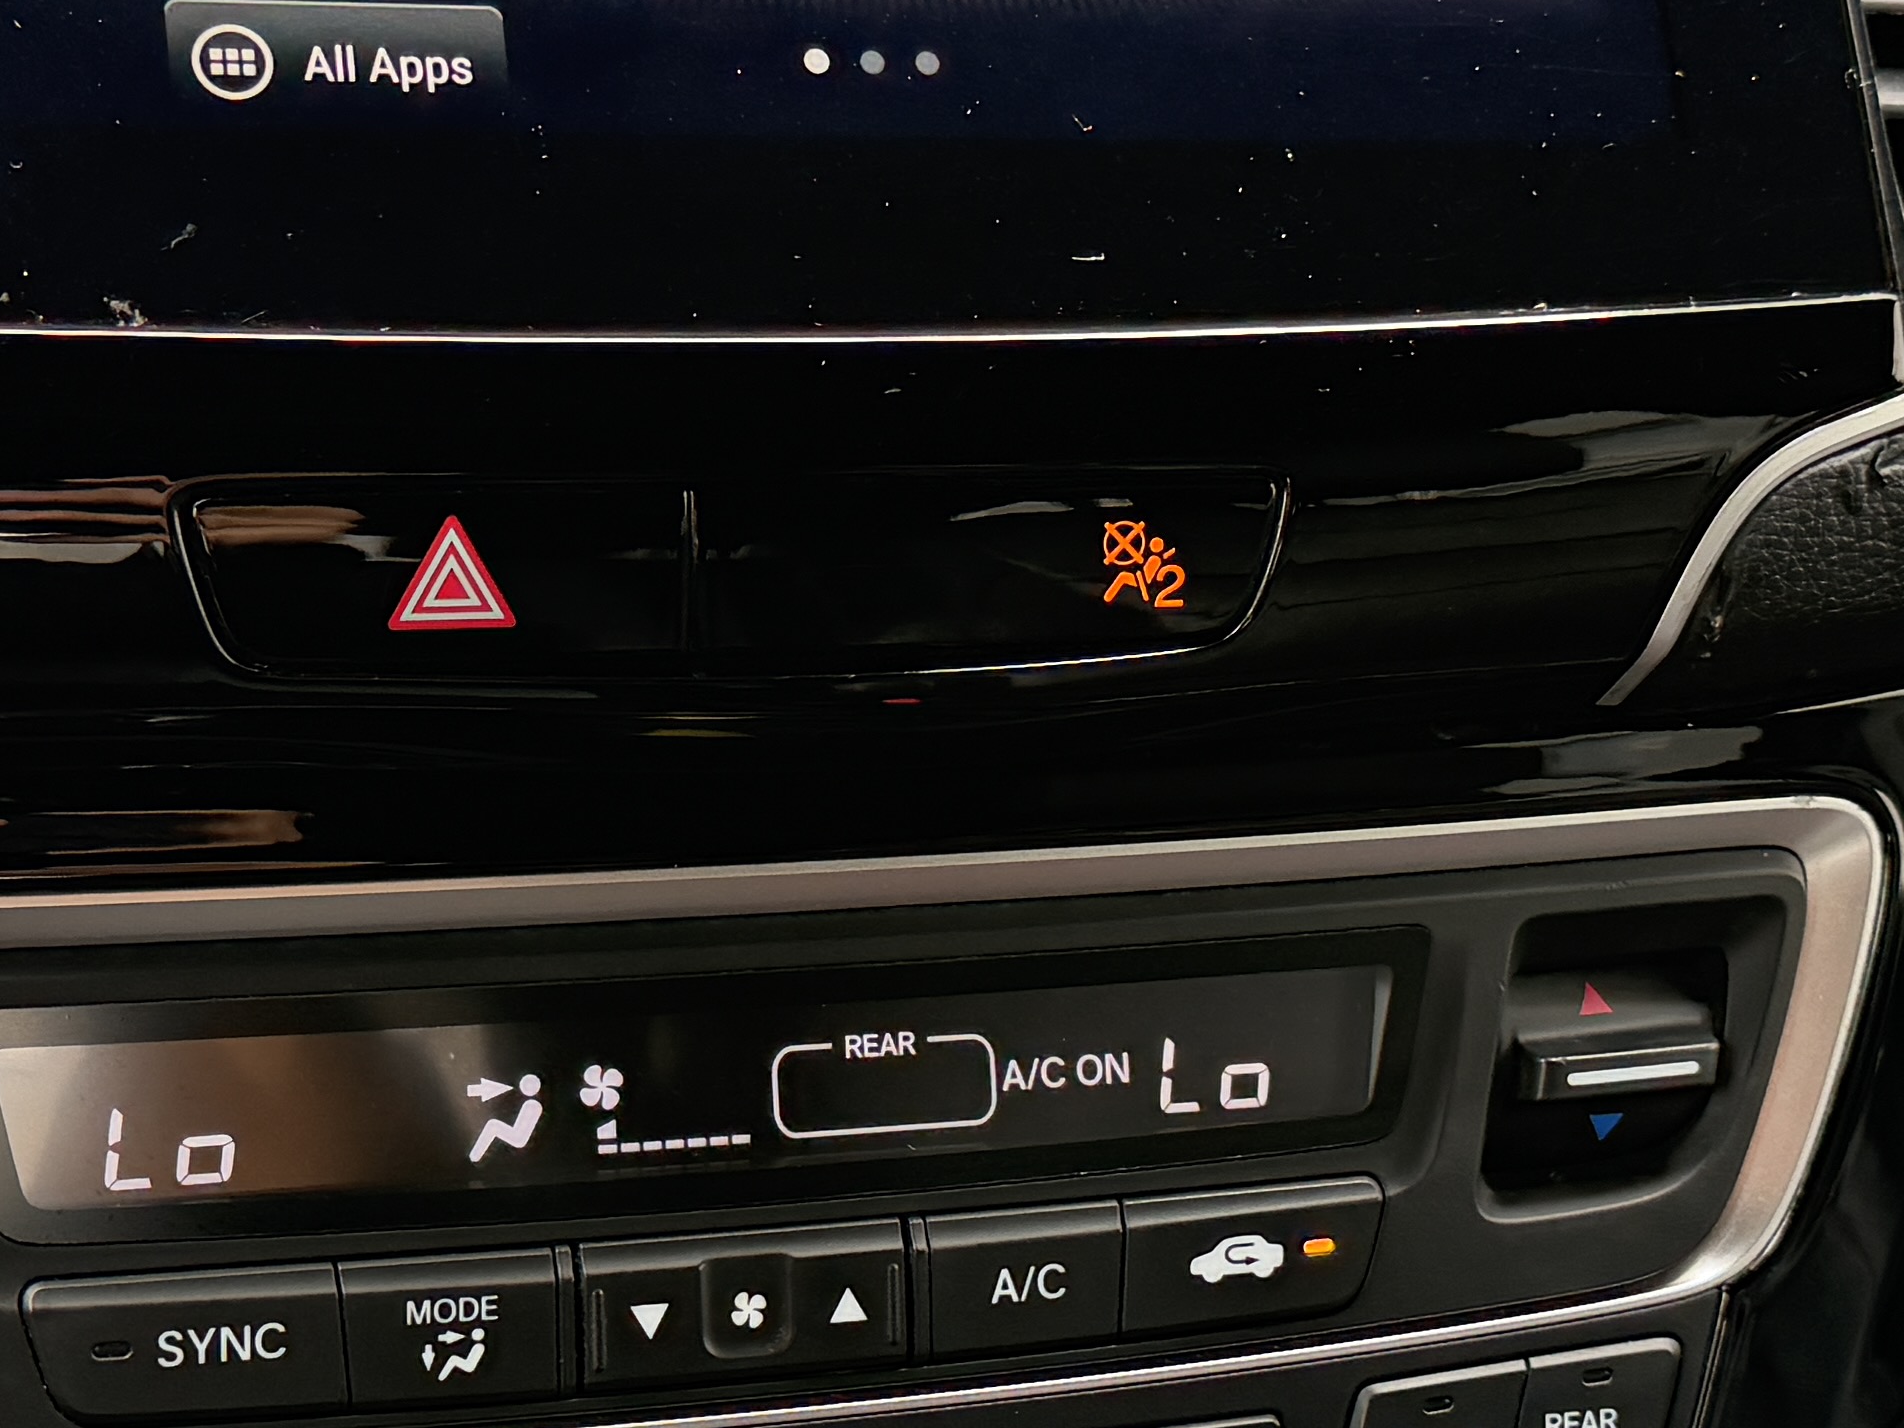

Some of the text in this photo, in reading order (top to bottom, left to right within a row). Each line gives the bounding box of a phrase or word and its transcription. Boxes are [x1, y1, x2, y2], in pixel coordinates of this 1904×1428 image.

[304, 44, 474, 93] All Apps
[843, 1029, 918, 1061] REAR
[1001, 1052, 1131, 1092] A/C ON
[1159, 1036, 1271, 1114] Lo
[103, 1106, 237, 1193] Lo
[989, 1262, 1068, 1306] A/C
[405, 1294, 500, 1327] MODE
[156, 1322, 288, 1369] SYNC
